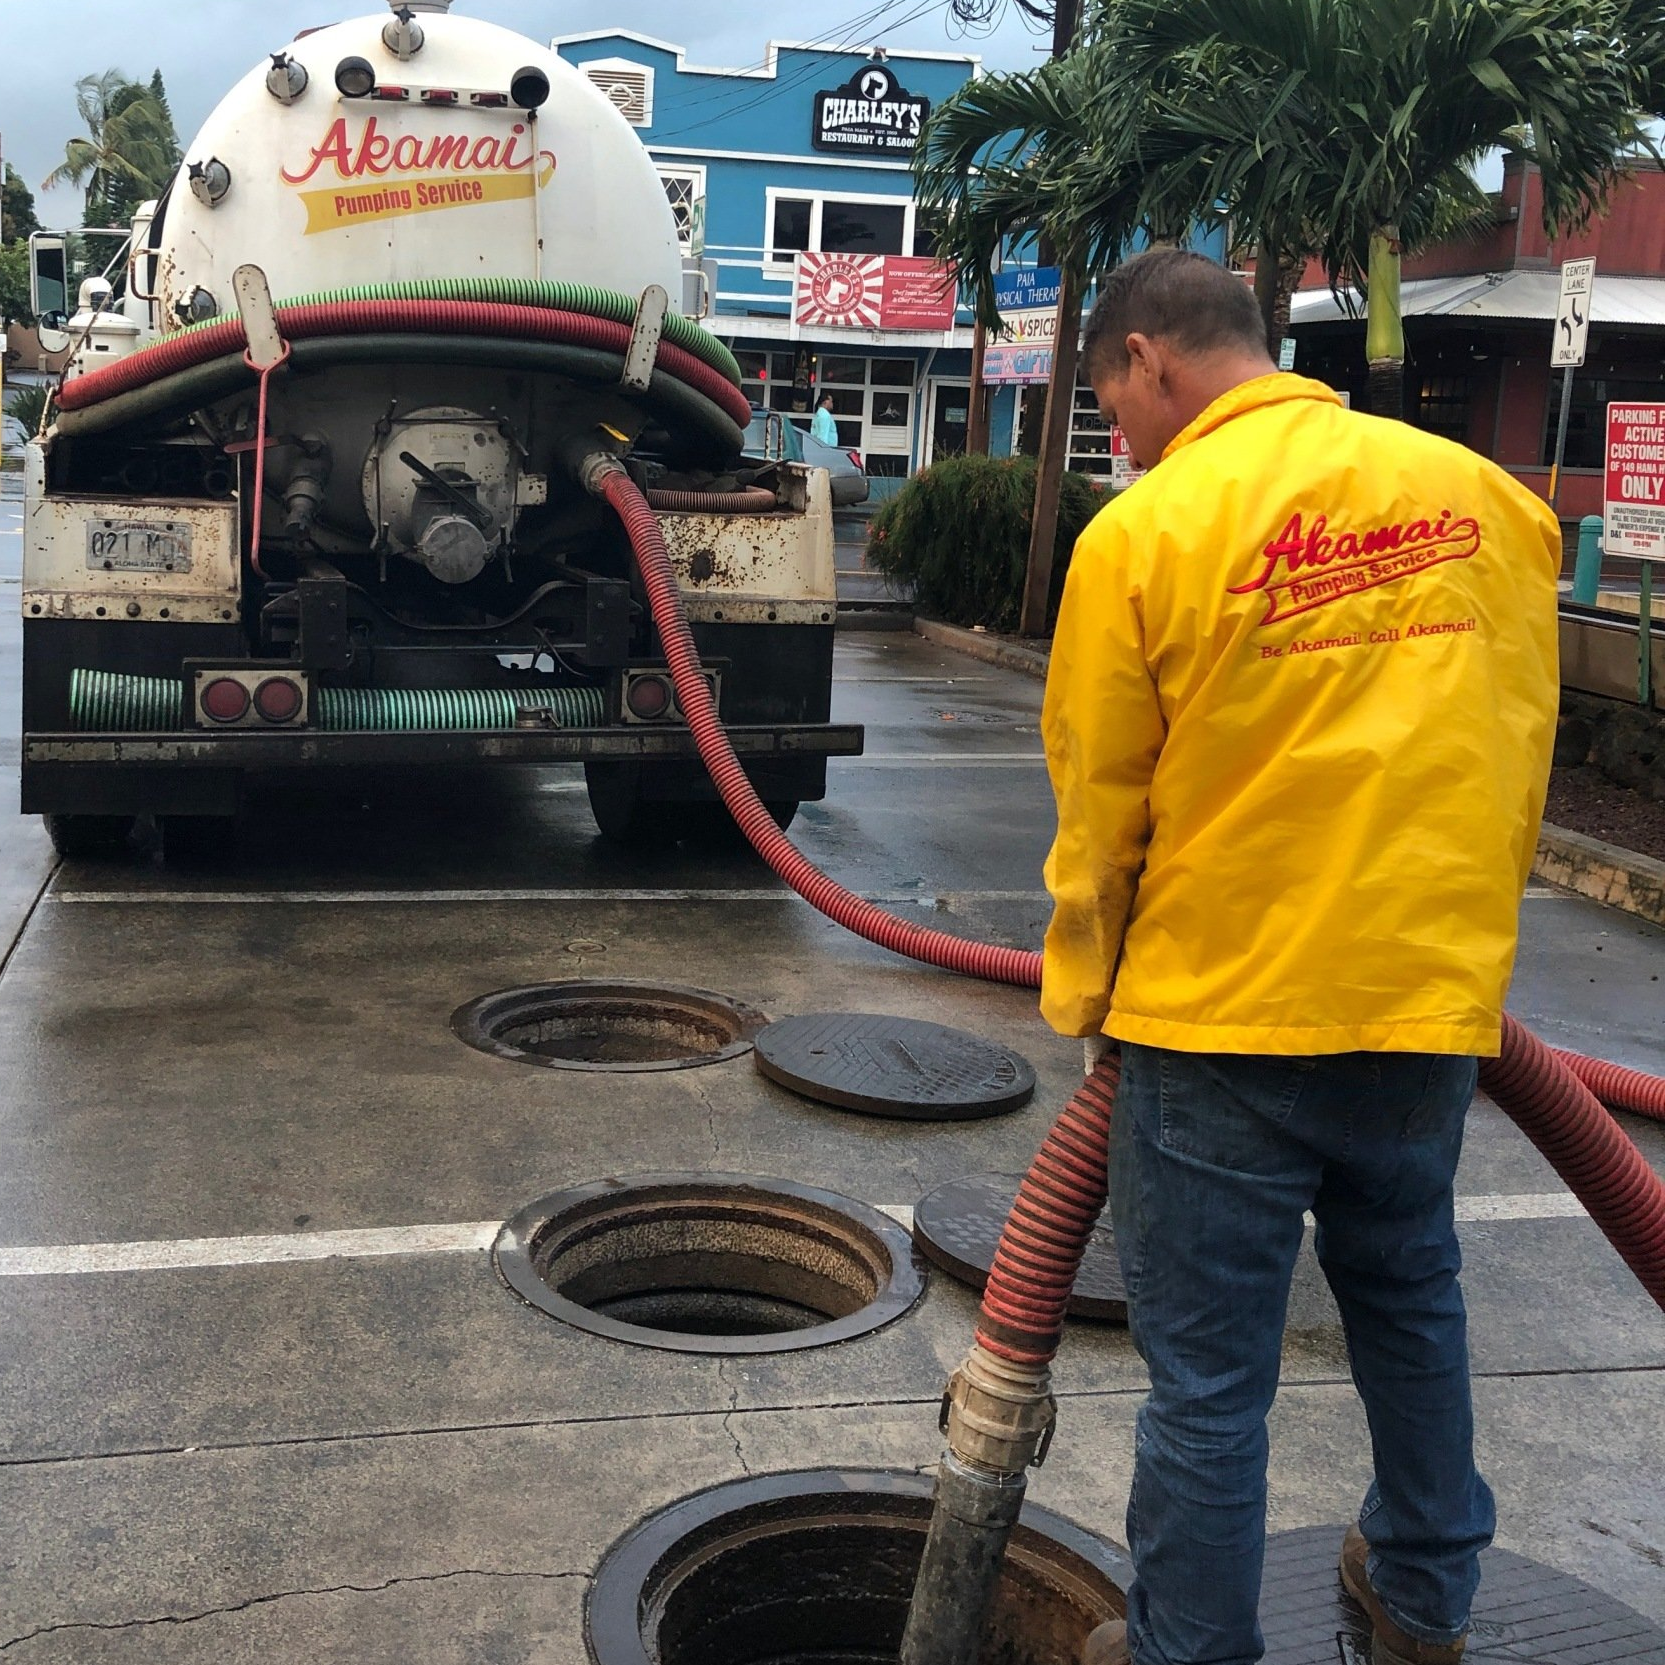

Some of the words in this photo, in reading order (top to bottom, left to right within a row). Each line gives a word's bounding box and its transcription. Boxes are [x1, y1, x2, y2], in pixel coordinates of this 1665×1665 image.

[822, 97, 921, 136] CHARLEY'S
[822, 131, 874, 145] RESTAURANT
[877, 136, 884, 146] &
[280, 116, 557, 186] Akamai
[335, 188, 412, 217] Pumping
[416, 179, 483, 206] Service
[1016, 272, 1035, 287] PAIA
[1565, 264, 1590, 277] CENTER
[1567, 279, 1585, 290] LANE
[995, 290, 1023, 306] HYSICAL
[1028, 286, 1060, 303] THERAP
[1560, 349, 1576, 360] ONLY
[1611, 409, 1656, 425] PARKING
[1624, 426, 1664, 443] ACTIVE
[1610, 443, 1665, 461] CUSTOME
[1610, 461, 1620, 472] OF
[1622, 462, 1635, 473] 149
[1636, 463, 1657, 474] HANA
[1621, 474, 1664, 500] ONLY
[92, 531, 130, 558] 021
[1227, 509, 1480, 594] Akamai
[1290, 568, 1367, 604] Pumping
[1369, 548, 1437, 579] Service
[1261, 645, 1282, 659] Be
[1289, 633, 1361, 655] Akamai!
[1369, 629, 1400, 643] Call
[1406, 619, 1476, 639] Akamai!
